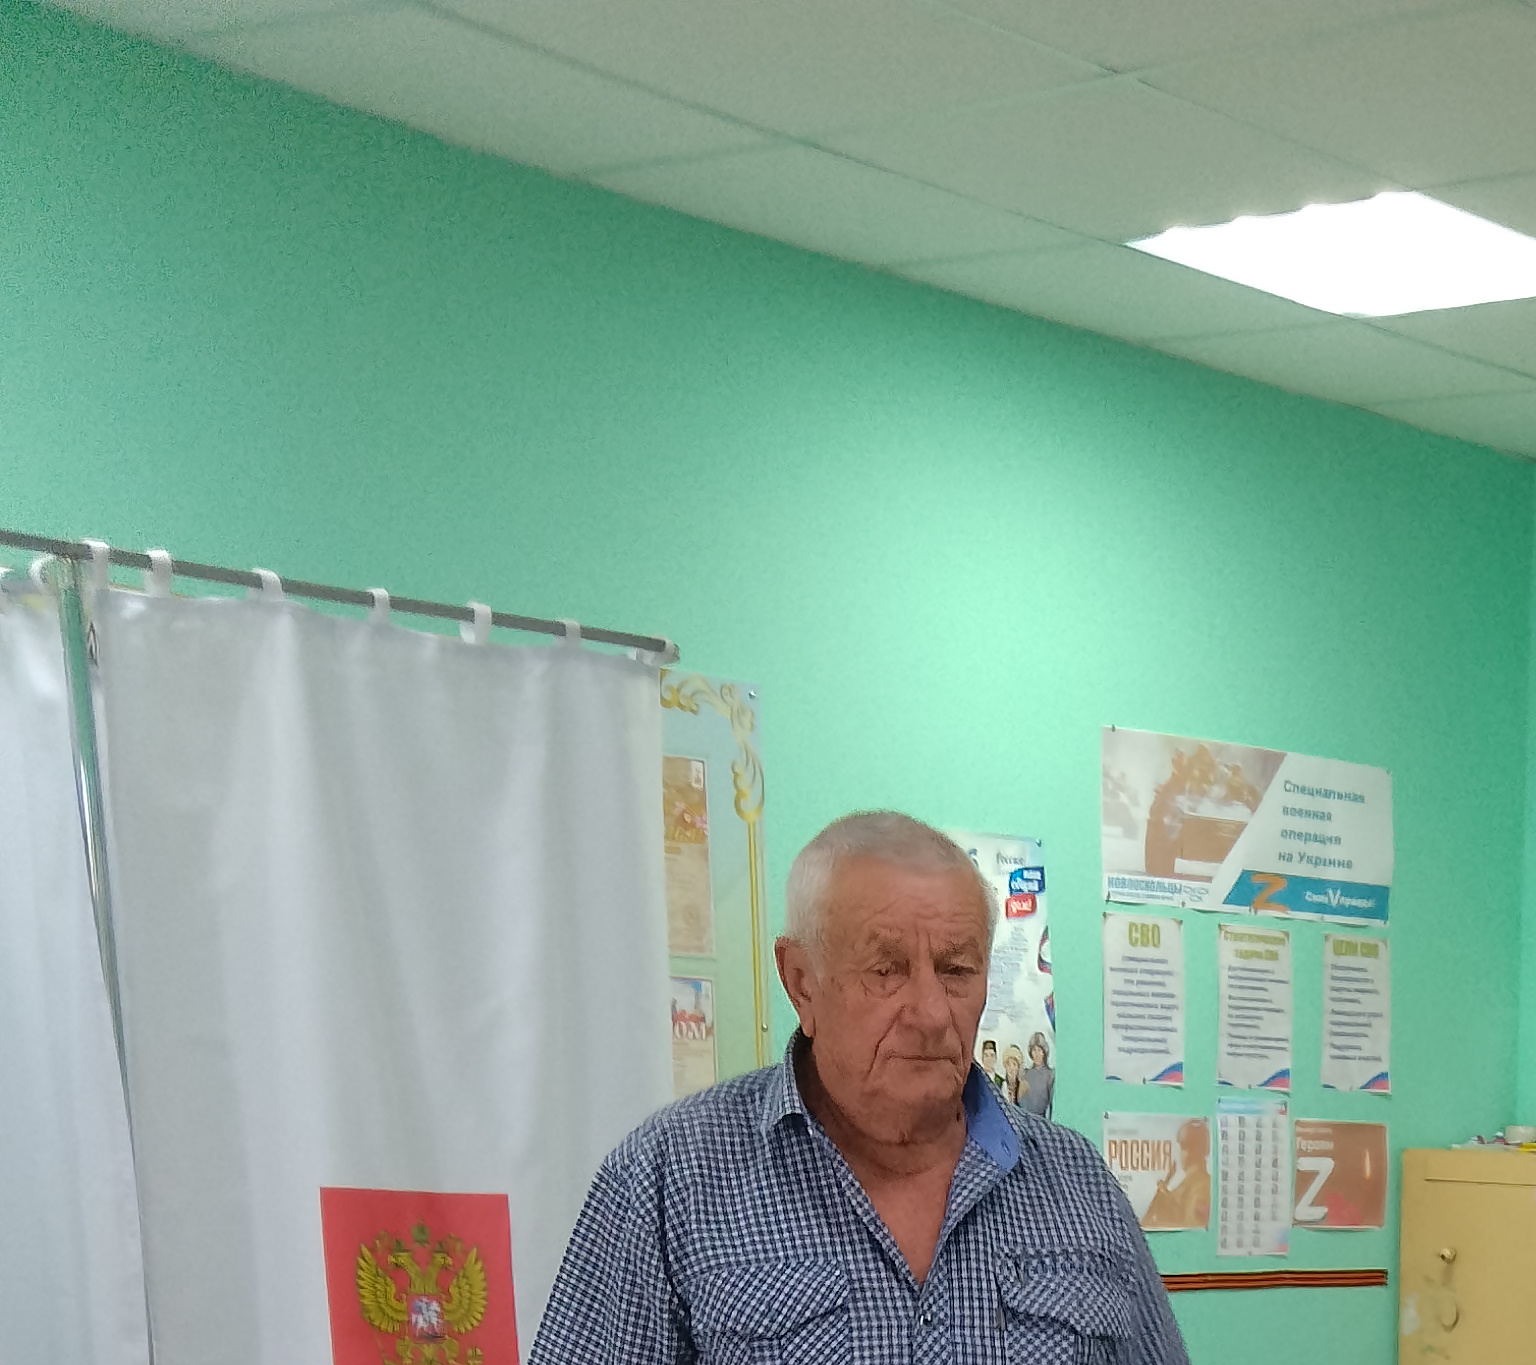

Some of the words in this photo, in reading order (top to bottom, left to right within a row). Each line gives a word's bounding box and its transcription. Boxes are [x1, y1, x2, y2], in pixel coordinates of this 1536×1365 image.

[1283, 780, 1365, 803] Специальная
[1281, 805, 1333, 821] военная
[1279, 828, 1342, 846] операция
[1278, 851, 1294, 863] на
[1297, 851, 1353, 869] Украине
[1108, 1139, 1172, 1172] РОССИЯ
